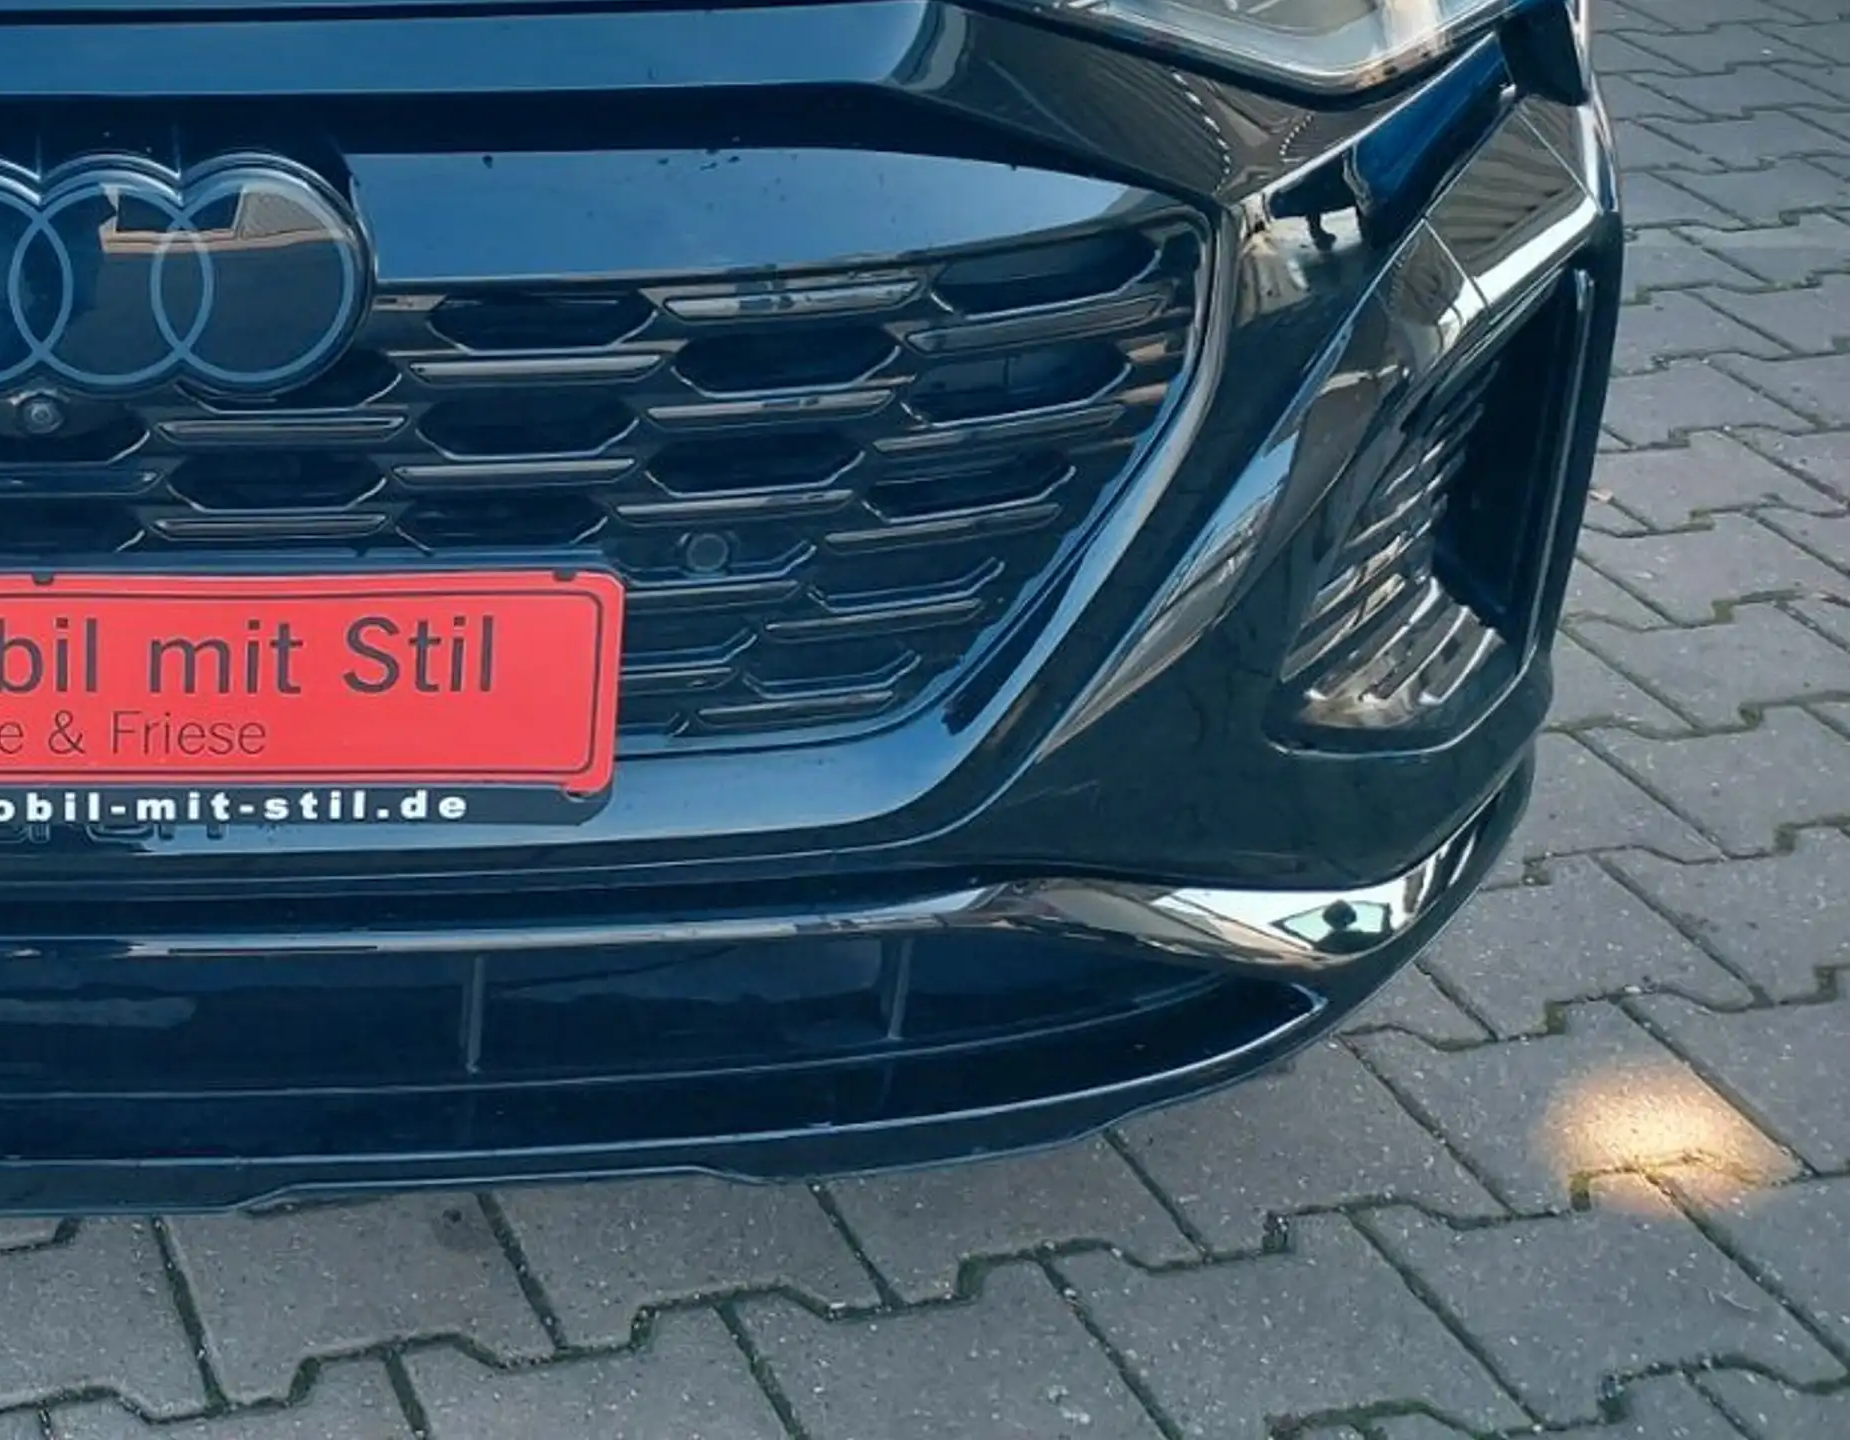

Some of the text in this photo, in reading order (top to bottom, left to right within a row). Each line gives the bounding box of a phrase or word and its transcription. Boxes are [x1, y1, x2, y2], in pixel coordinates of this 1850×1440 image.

[148, 618, 304, 695] mit
[342, 615, 495, 694] Stil
[48, 709, 86, 755] &
[111, 709, 267, 755] Friese
